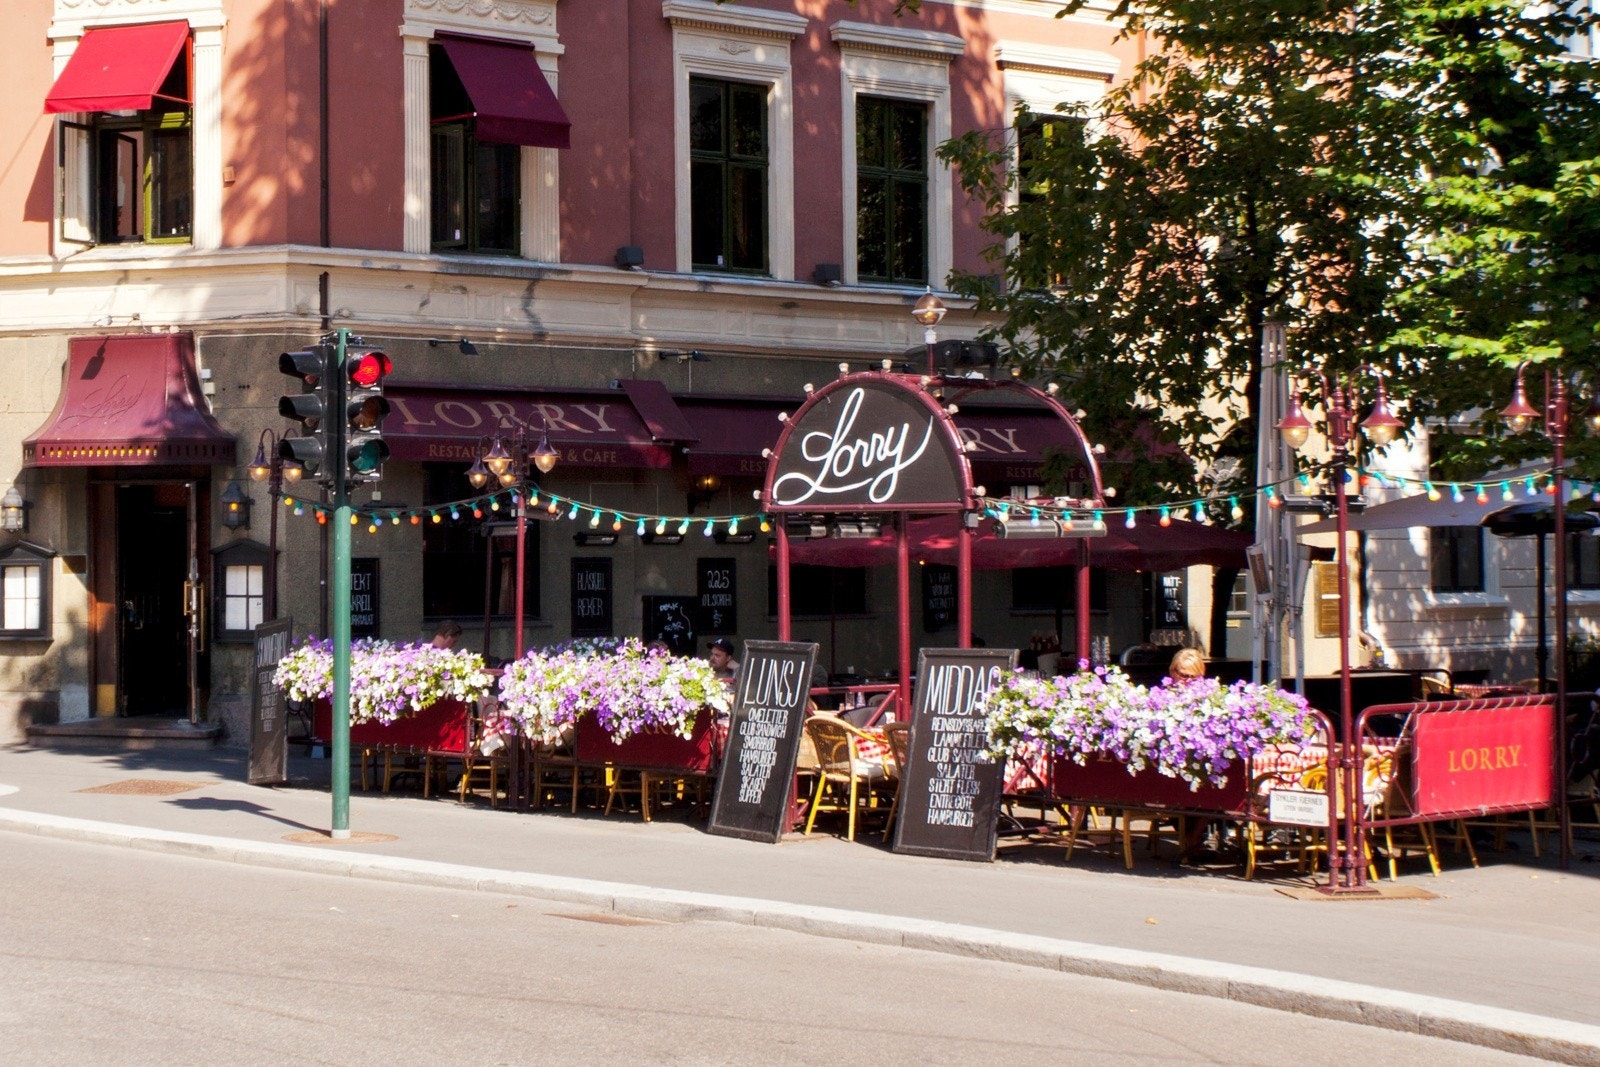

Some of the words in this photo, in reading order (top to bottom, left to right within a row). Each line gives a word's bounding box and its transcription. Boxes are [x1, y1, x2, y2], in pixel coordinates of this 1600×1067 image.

[387, 397, 617, 433] LORRY
[773, 387, 933, 505] Lorry
[350, 572, 372, 591] TEKT
[743, 657, 806, 708] LUNSJ
[927, 747, 950, 763] CLUB
[1448, 744, 1522, 773] LORRY
[741, 762, 772, 779] SALATER
[937, 763, 976, 780] SALATER
[927, 808, 975, 828] HAMBURGER
